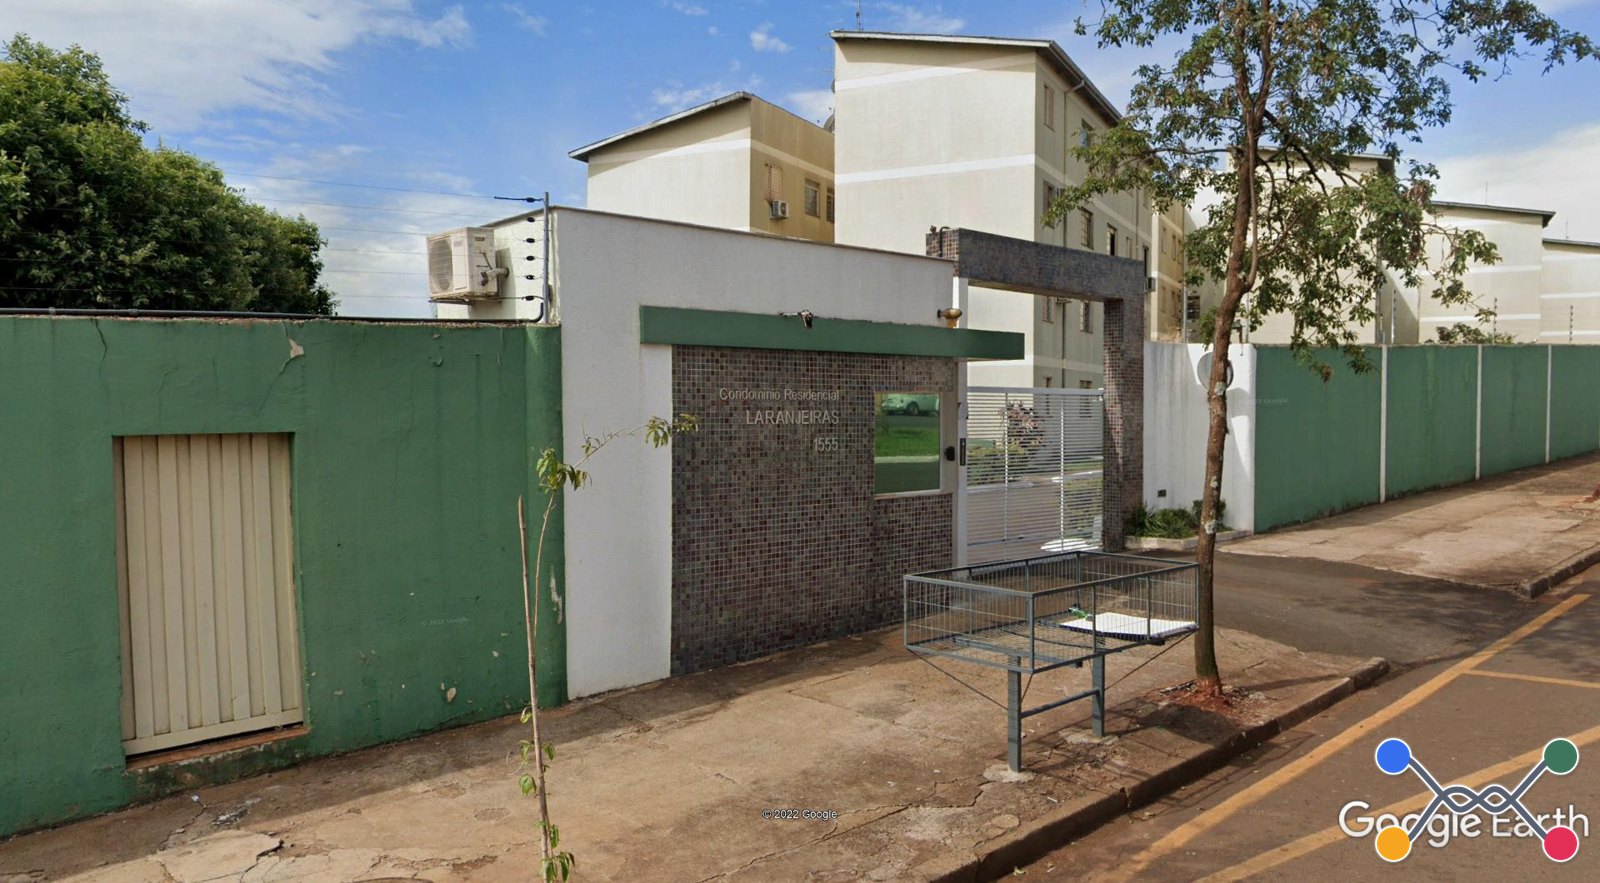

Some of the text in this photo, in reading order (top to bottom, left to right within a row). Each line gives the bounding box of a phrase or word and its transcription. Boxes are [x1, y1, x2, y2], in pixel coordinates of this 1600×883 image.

[783, 388, 839, 401] Residencial
[746, 410, 839, 425] LARANJEIRAS
[813, 438, 838, 452] 1555
